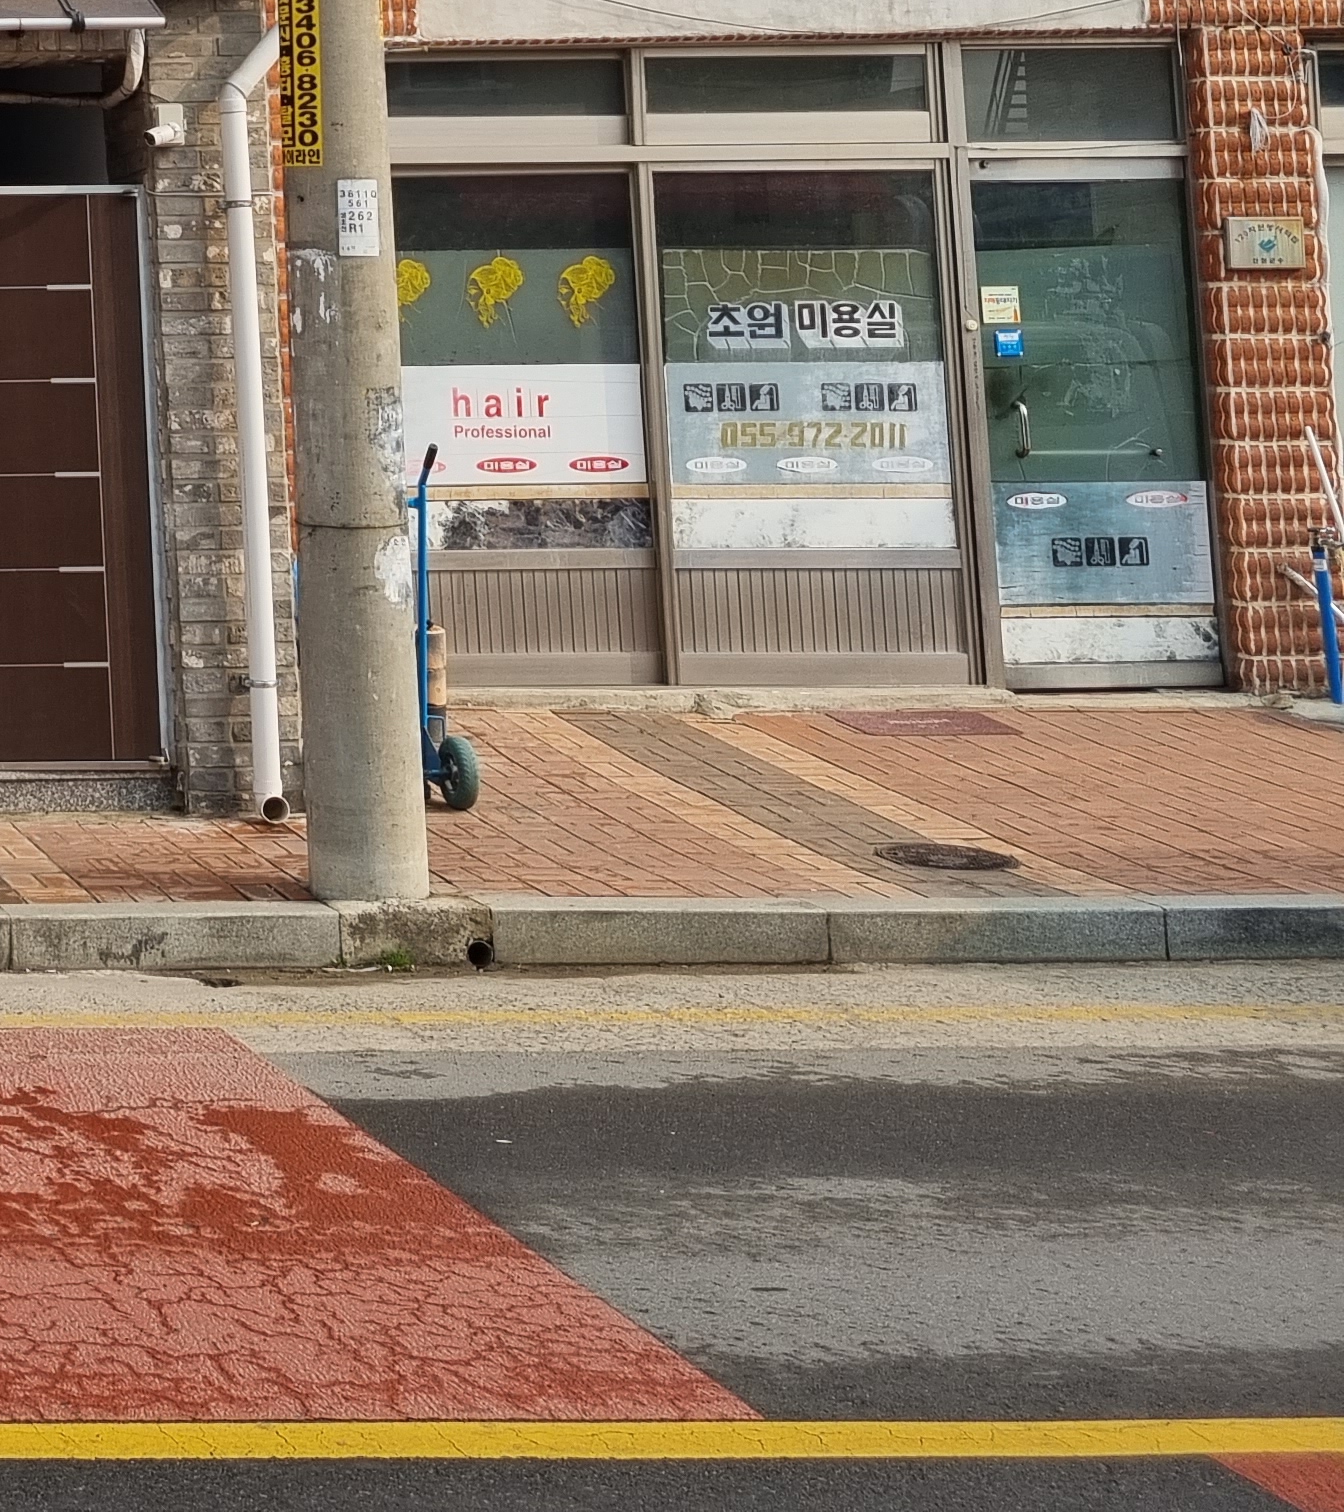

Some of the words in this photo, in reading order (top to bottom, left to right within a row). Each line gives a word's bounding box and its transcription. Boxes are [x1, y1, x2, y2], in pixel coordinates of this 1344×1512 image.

[348, 210, 373, 221] 262
[707, 302, 784, 340] 초원
[797, 301, 898, 340] 미용실
[451, 386, 550, 418] hair
[454, 424, 551, 439] Professional
[483, 460, 531, 471] 미용실
[576, 459, 623, 471] 미용실
